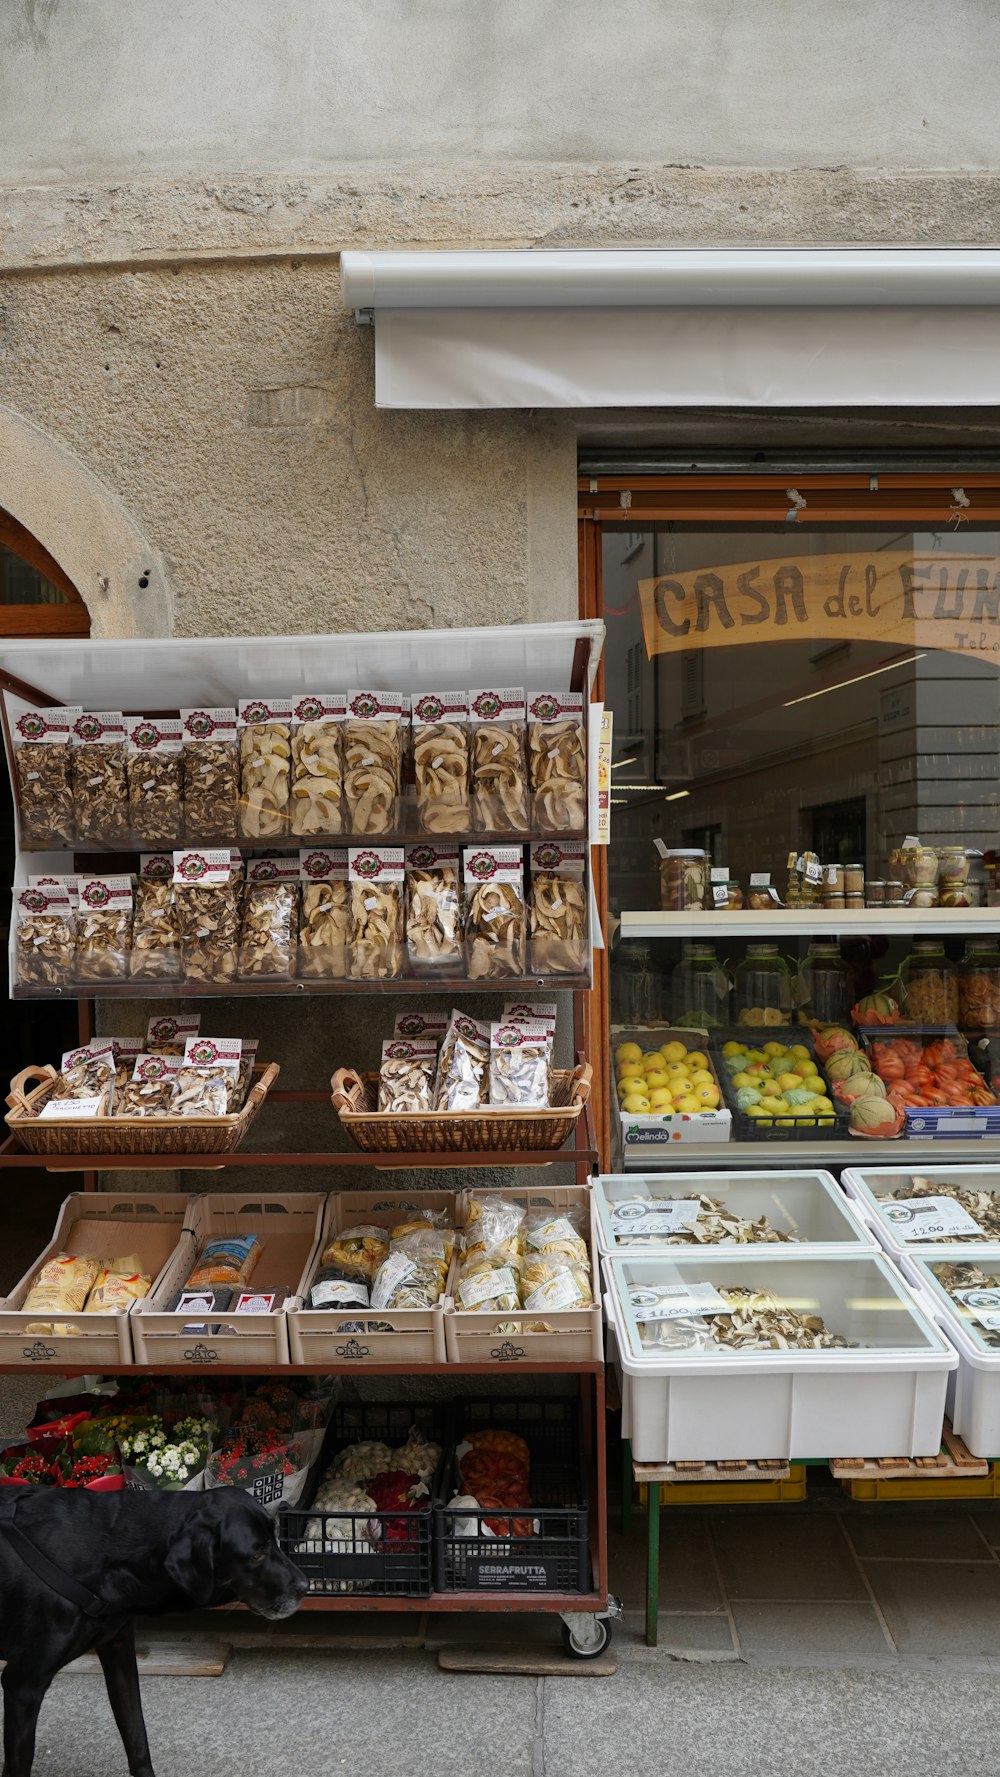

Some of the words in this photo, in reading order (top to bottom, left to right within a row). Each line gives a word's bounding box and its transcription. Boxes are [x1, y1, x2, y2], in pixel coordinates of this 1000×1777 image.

[654, 565, 809, 637] CASA
[822, 563, 881, 618] del
[626, 1131, 668, 1141] Melinda
[479, 1565, 546, 1575] SERRAFRUTTA
